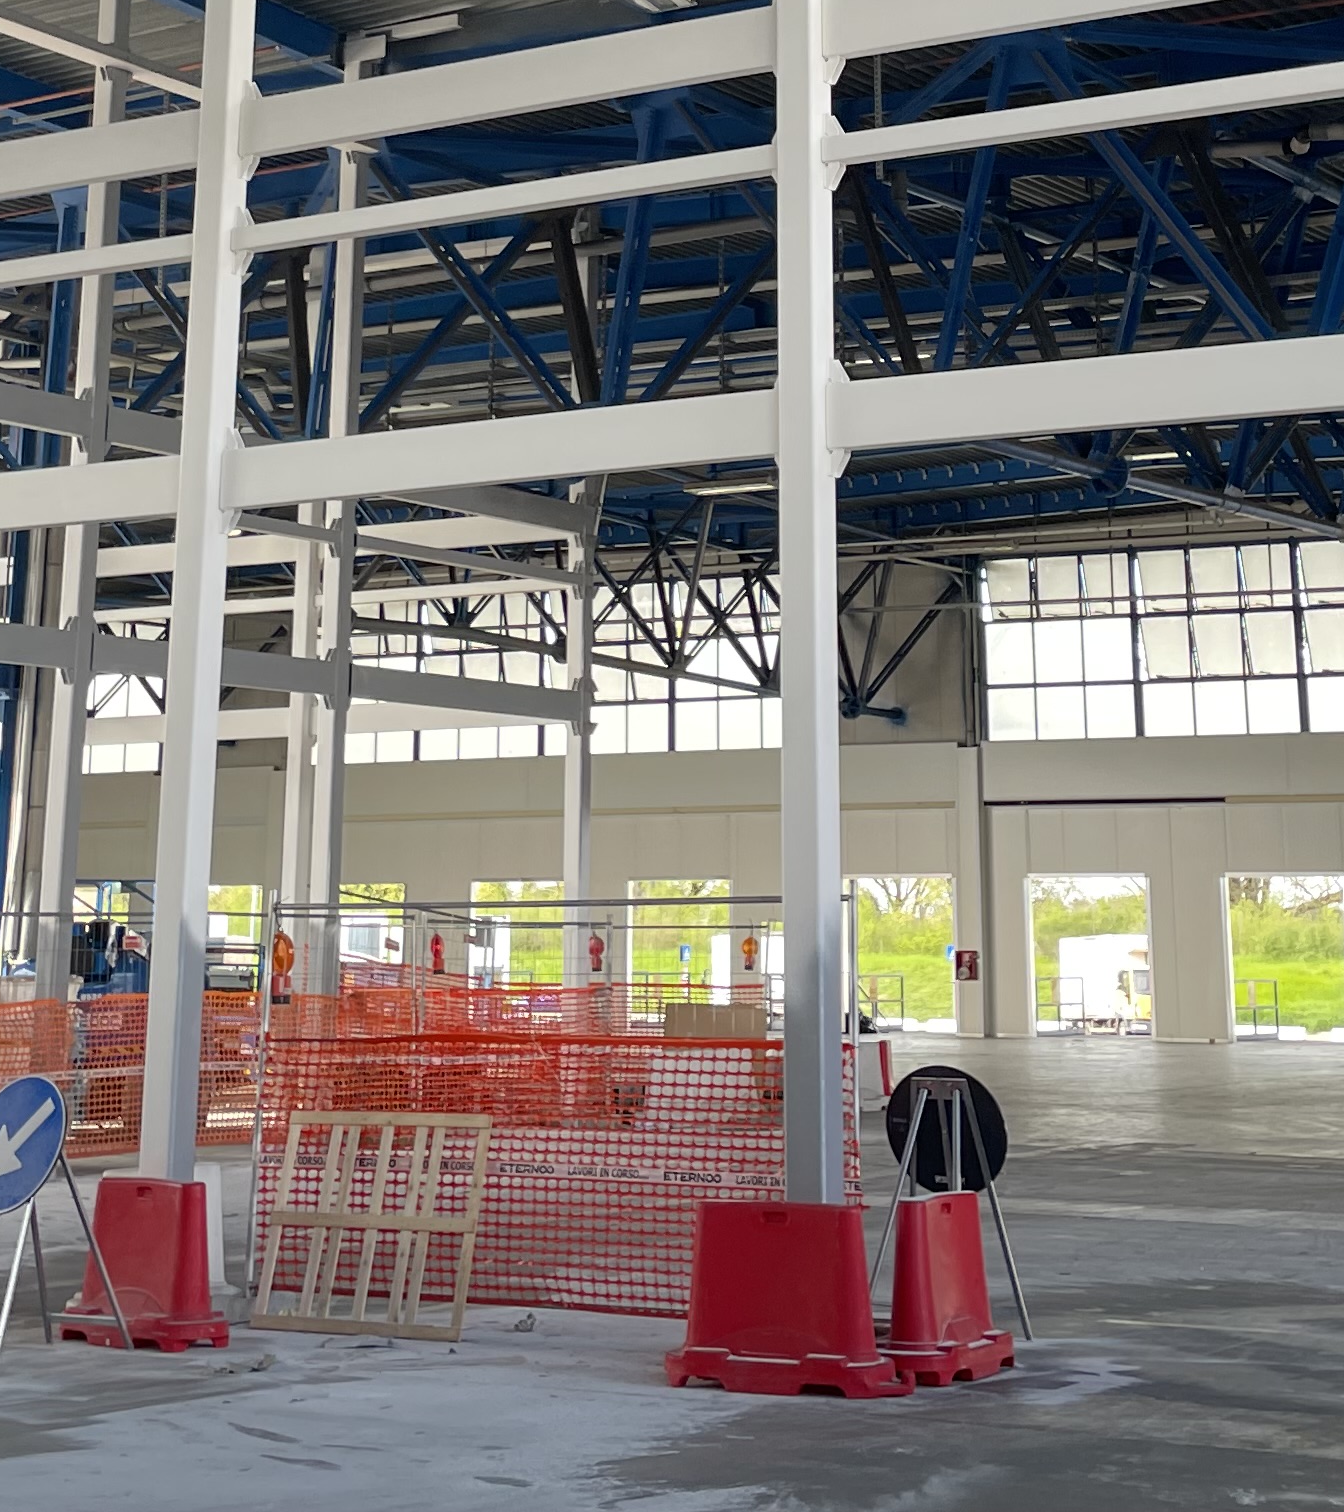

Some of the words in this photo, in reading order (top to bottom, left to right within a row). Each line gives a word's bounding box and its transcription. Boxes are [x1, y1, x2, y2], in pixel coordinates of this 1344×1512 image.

[567, 1166, 598, 1177] LAVORI
[735, 1175, 768, 1186] LAVORI
[769, 1176, 780, 1187] IN
